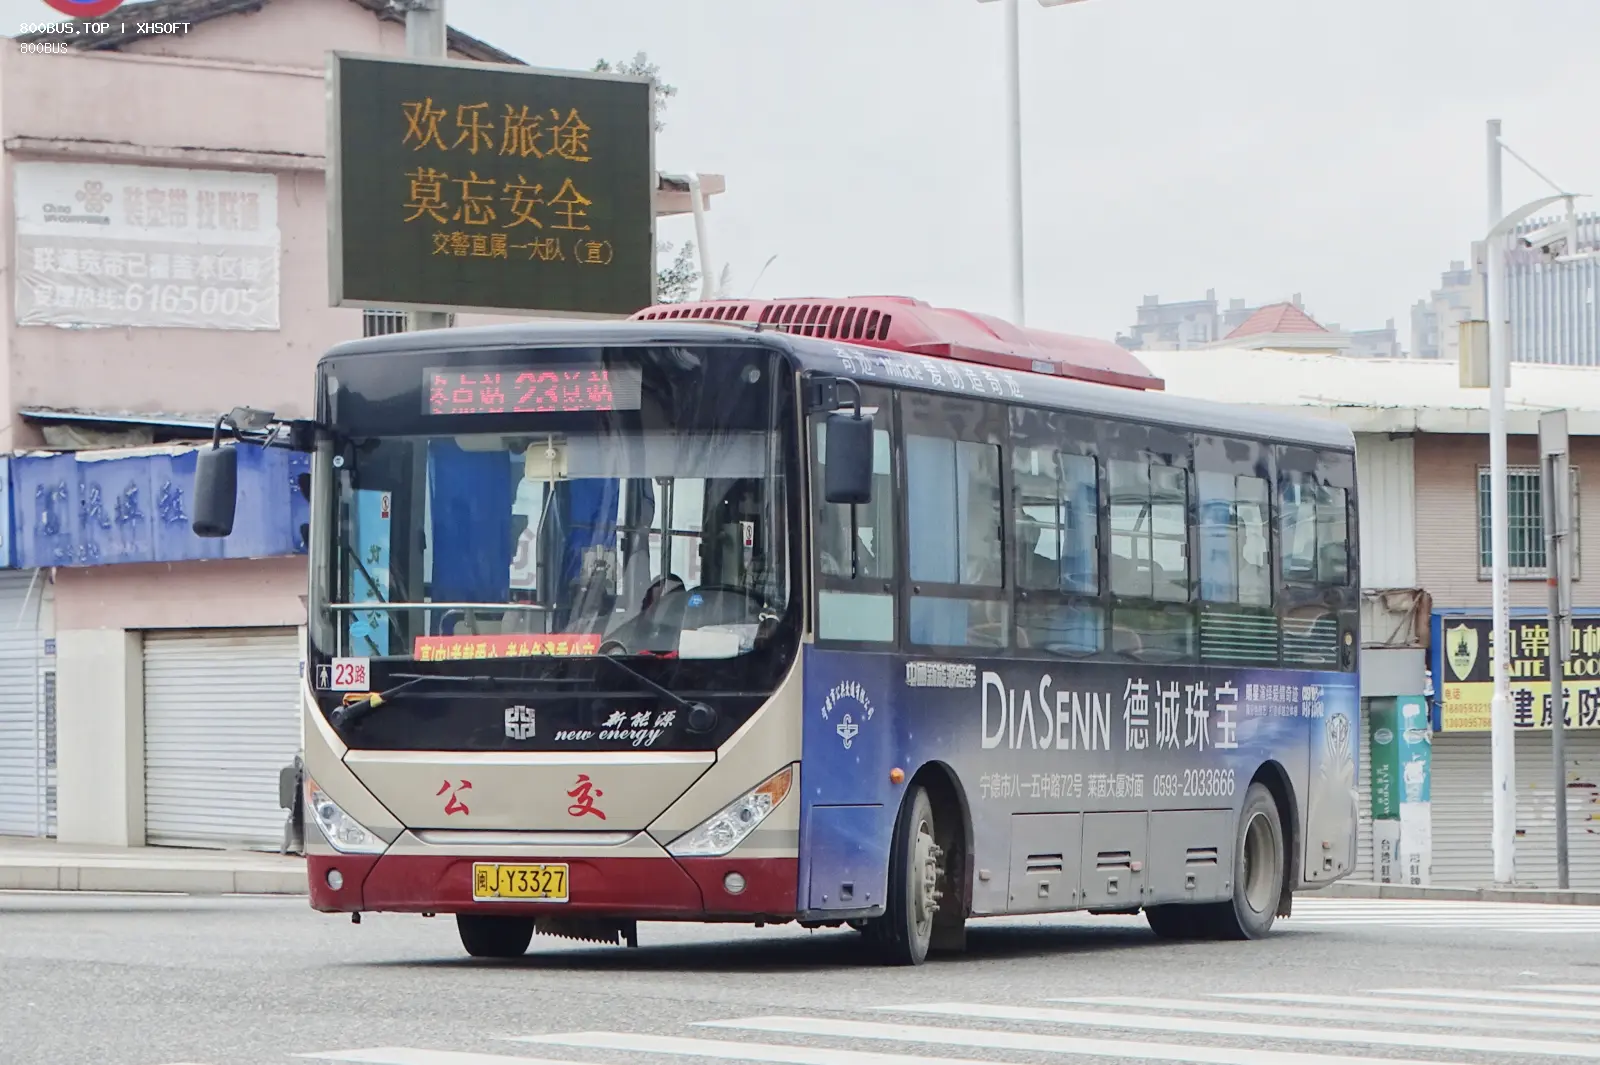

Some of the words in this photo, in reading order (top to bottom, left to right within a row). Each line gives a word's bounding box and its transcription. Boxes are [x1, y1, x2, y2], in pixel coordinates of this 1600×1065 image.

[401, 96, 593, 162] 欢乐旅途
[403, 167, 593, 230] 莫忘安全
[335, 663, 366, 686] 23路
[602, 710, 676, 727] 新能源
[1123, 678, 1239, 751] 德诚珠宝
[555, 729, 595, 741] new
[599, 729, 665, 747] energy
[980, 772, 1083, 798] 宁德市八一五中路72号
[1087, 773, 1144, 798] 莱茵大厦对面
[1153, 769, 1235, 797] 0593-2033666
